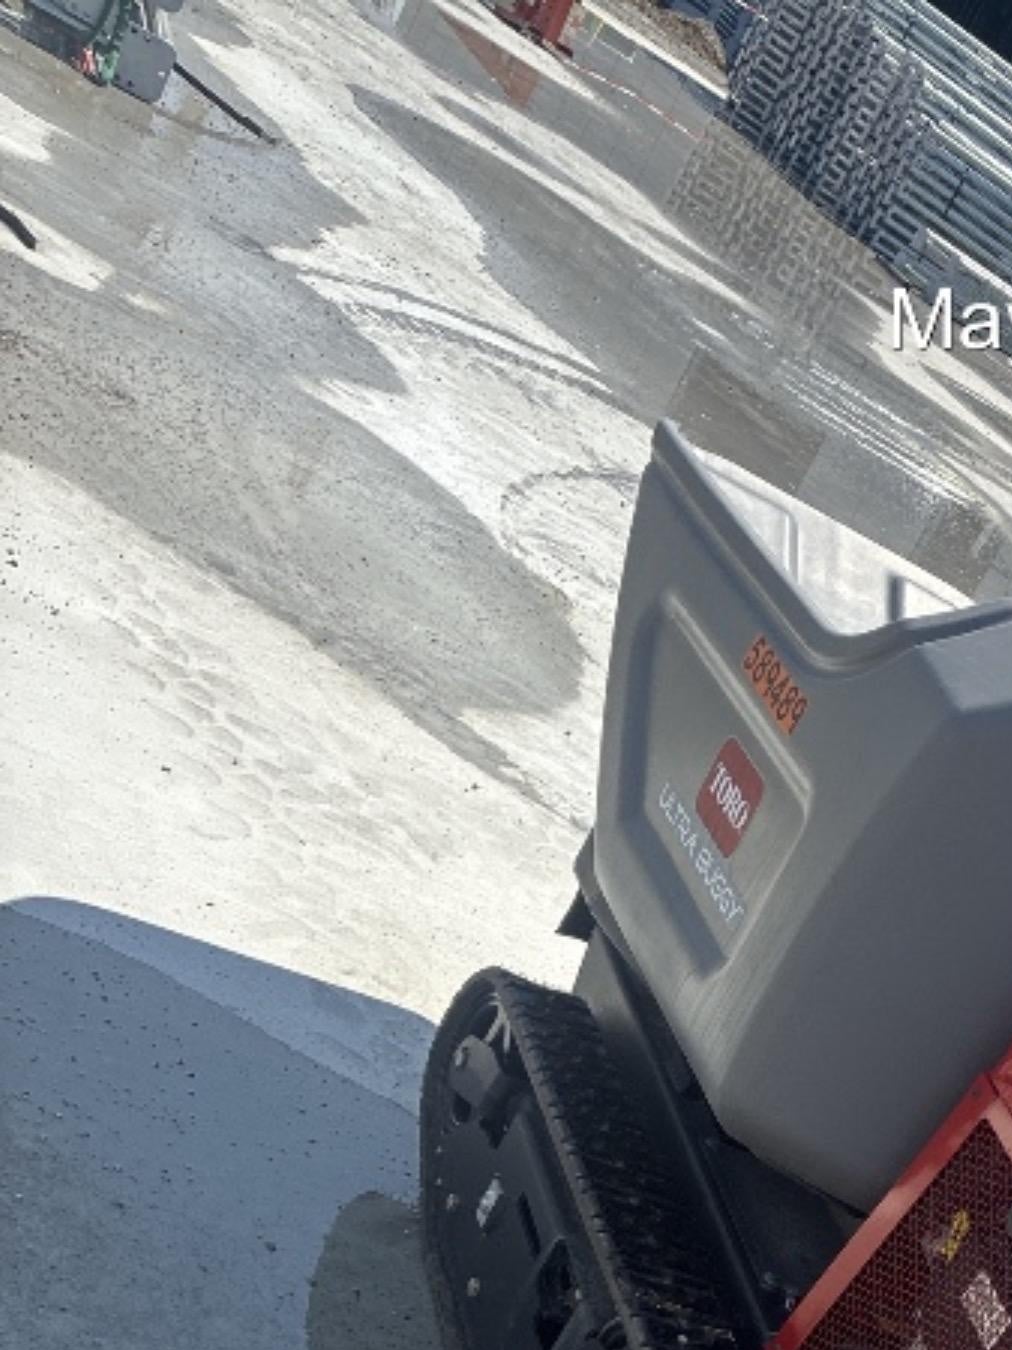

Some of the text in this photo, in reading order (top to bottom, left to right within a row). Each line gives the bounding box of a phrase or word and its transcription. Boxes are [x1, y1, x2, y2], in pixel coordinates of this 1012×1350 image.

[743, 633, 807, 736] 589489
[709, 761, 749, 830] TORO
[658, 782, 744, 921] ULTRA BUGGY
